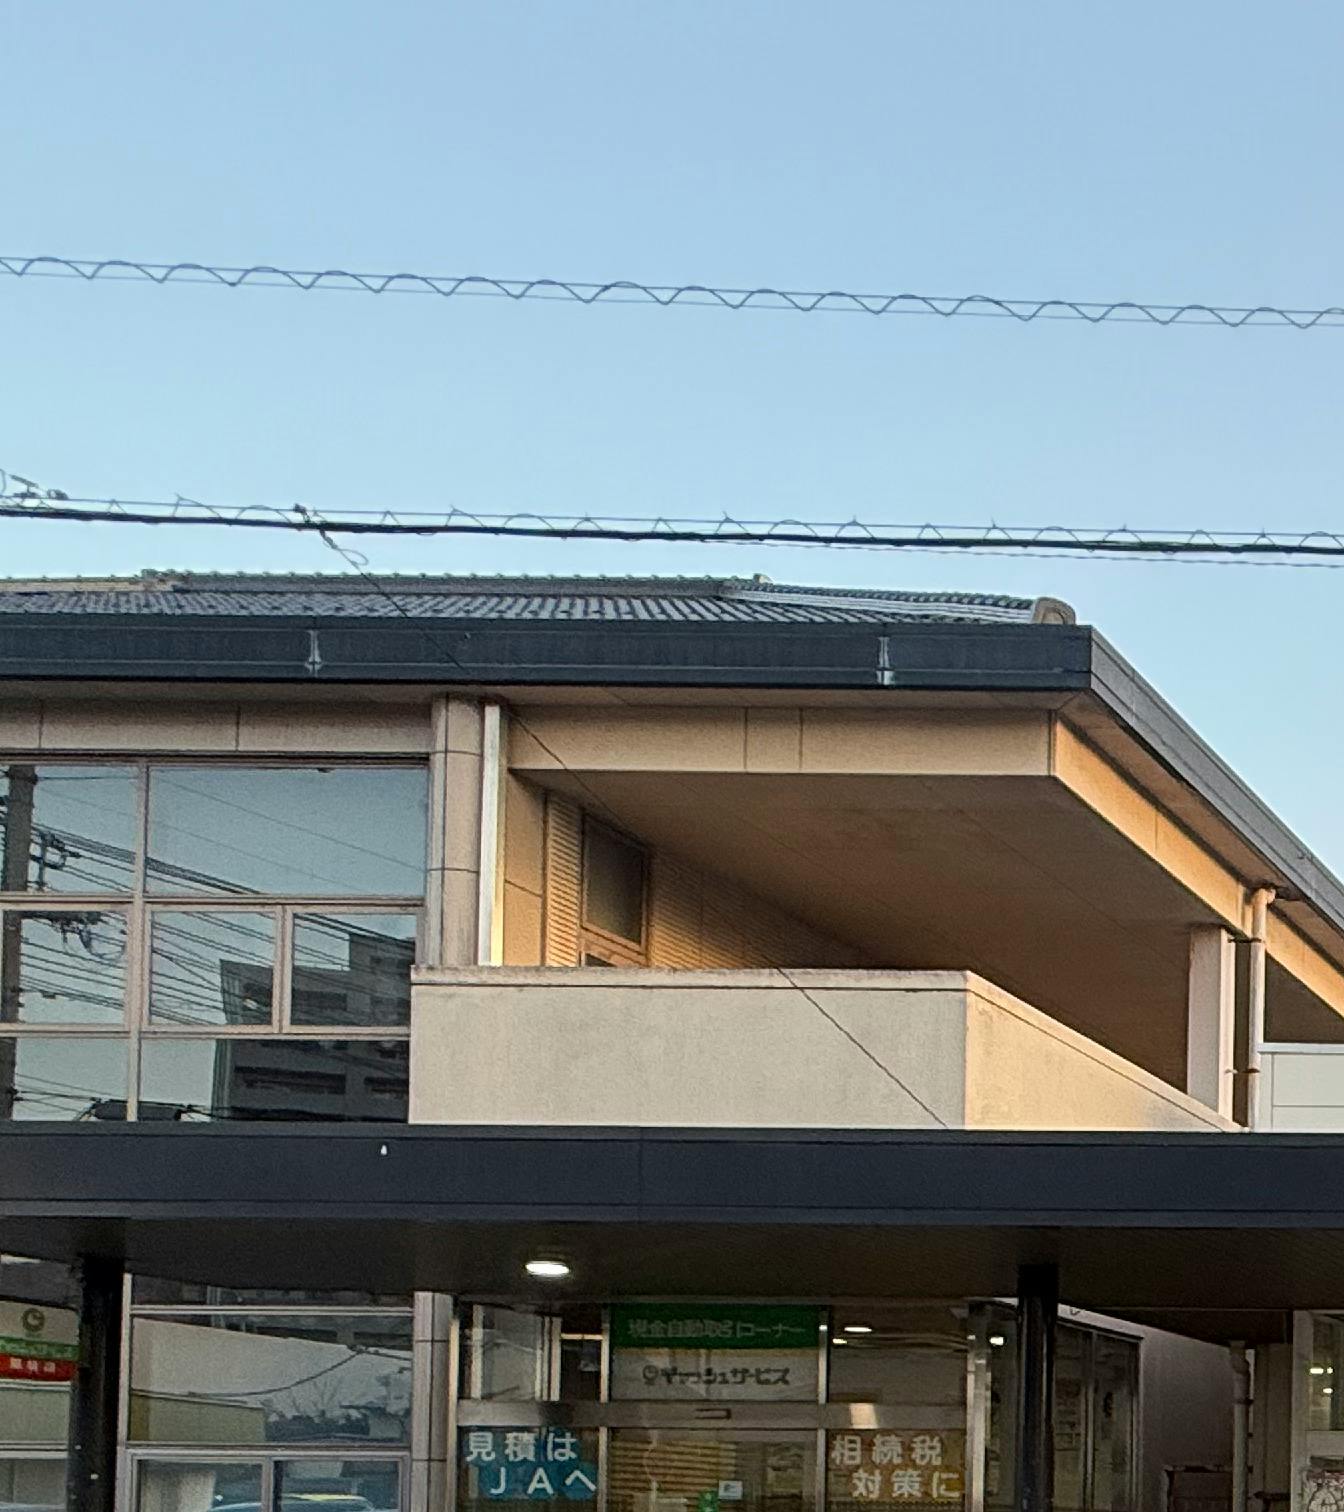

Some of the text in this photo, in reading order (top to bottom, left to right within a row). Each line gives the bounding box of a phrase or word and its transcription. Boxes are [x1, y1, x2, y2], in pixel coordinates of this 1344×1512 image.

[466, 1432, 577, 1461] 見積は
[831, 1434, 942, 1465] 相続税
[851, 1469, 960, 1499] 対策に
